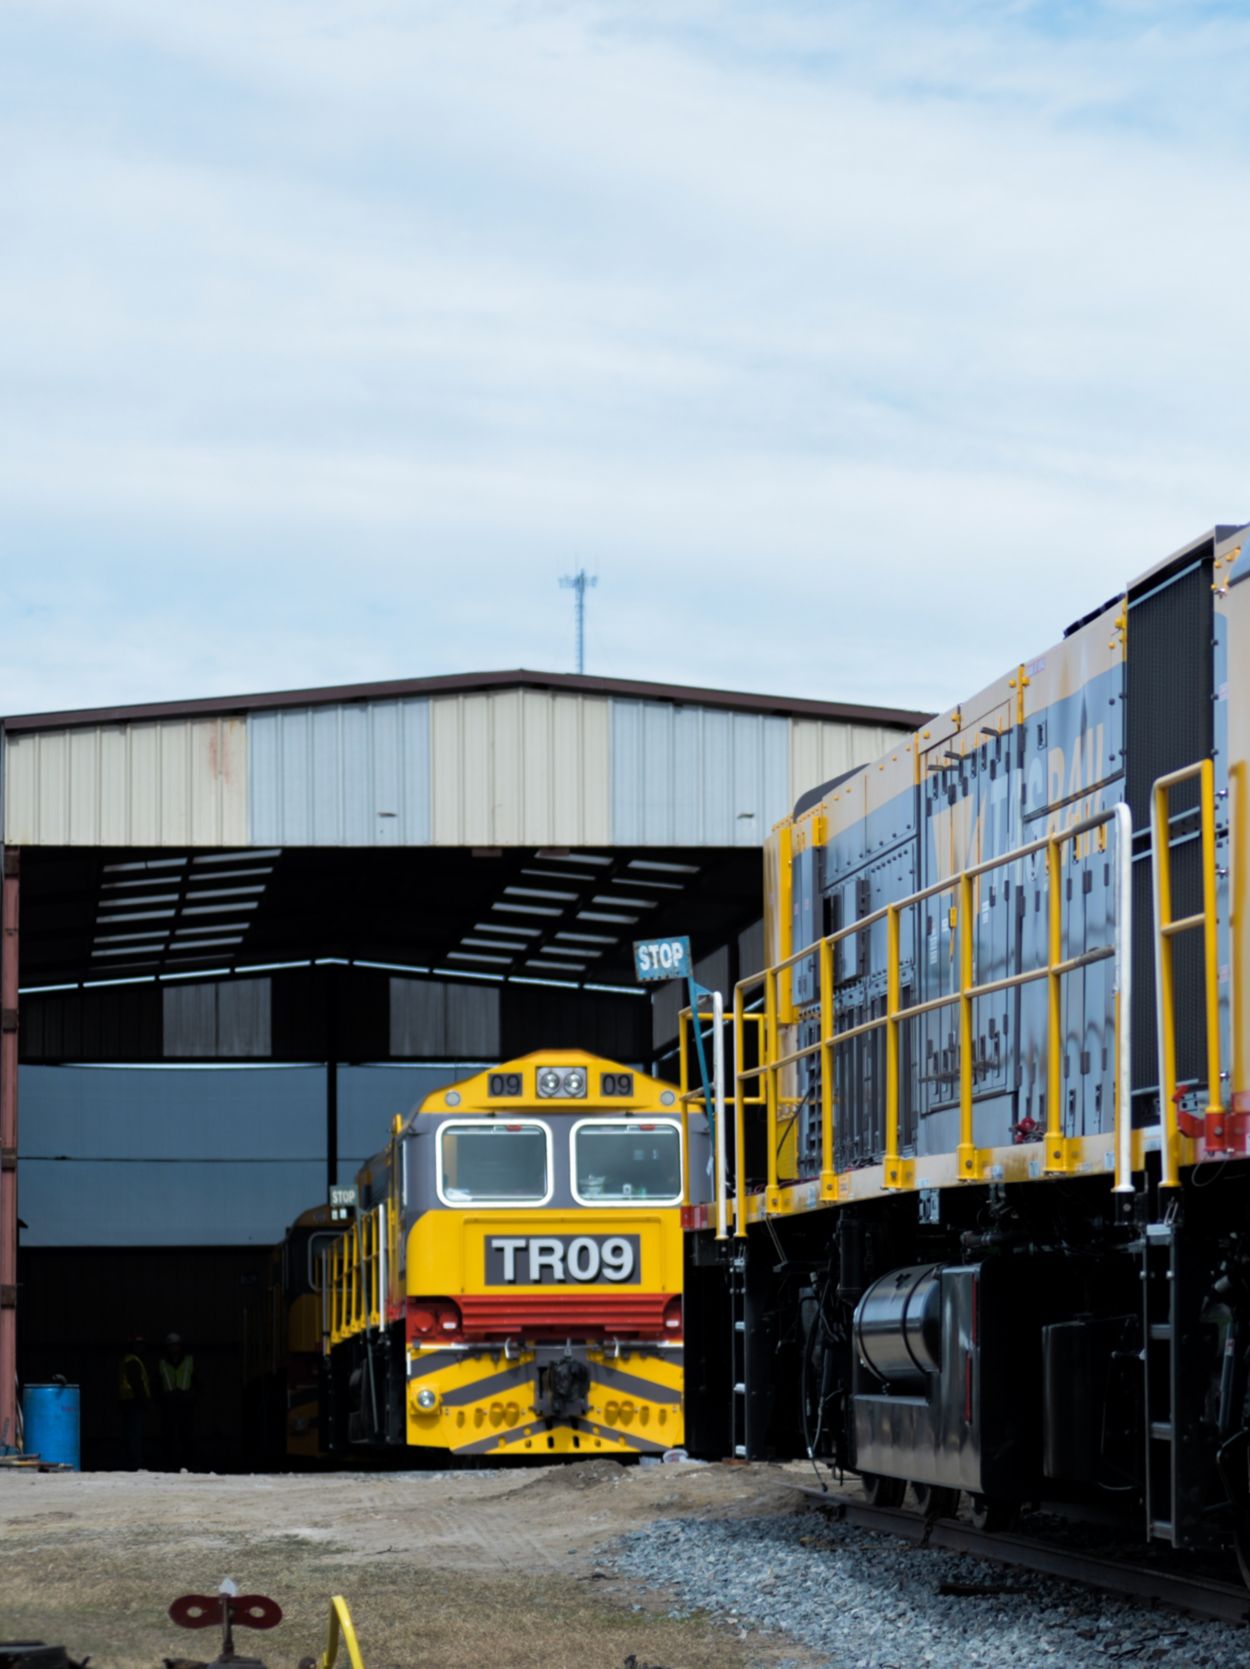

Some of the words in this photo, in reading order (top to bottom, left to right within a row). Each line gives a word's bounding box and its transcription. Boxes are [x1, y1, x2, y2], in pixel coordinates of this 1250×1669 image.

[638, 942, 684, 971] STOP
[489, 1074, 521, 1095] 09
[601, 1074, 633, 1095] 09
[332, 1190, 356, 1204] STOP
[491, 1236, 637, 1284] TR09
